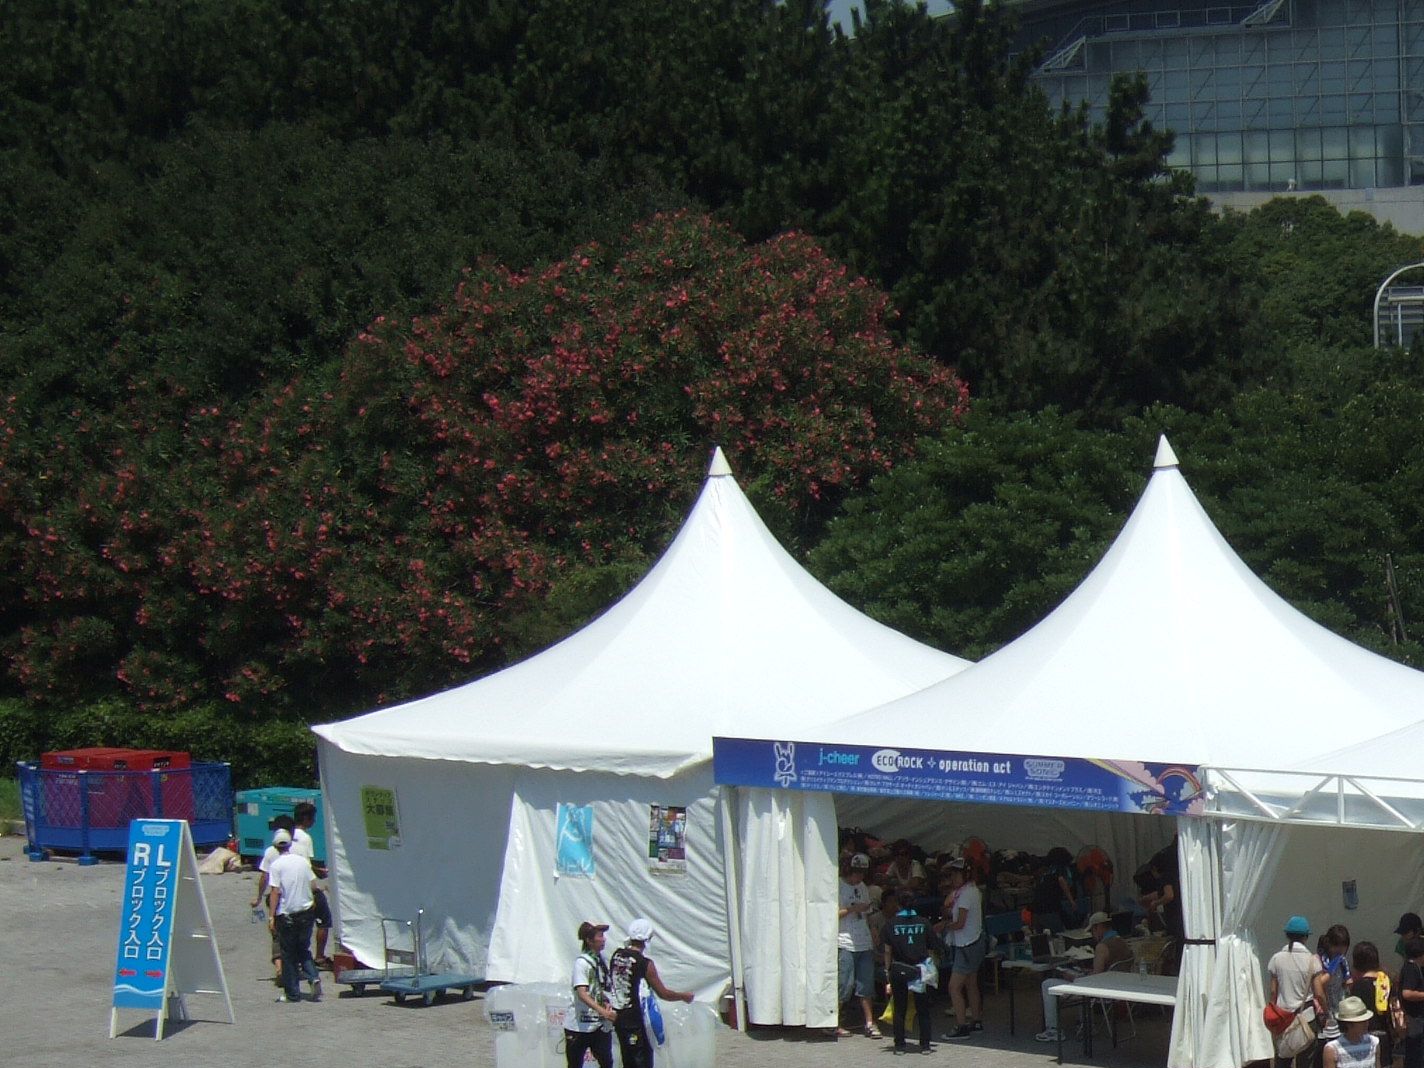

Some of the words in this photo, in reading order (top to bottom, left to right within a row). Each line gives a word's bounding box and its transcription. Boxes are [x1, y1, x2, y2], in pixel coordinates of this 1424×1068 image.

[818, 748, 860, 766] j-cheer
[938, 758, 989, 773] operation
[993, 760, 1011, 774] act
[124, 842, 151, 959] Rブロック入口
[146, 844, 172, 961] Lブロック入口
